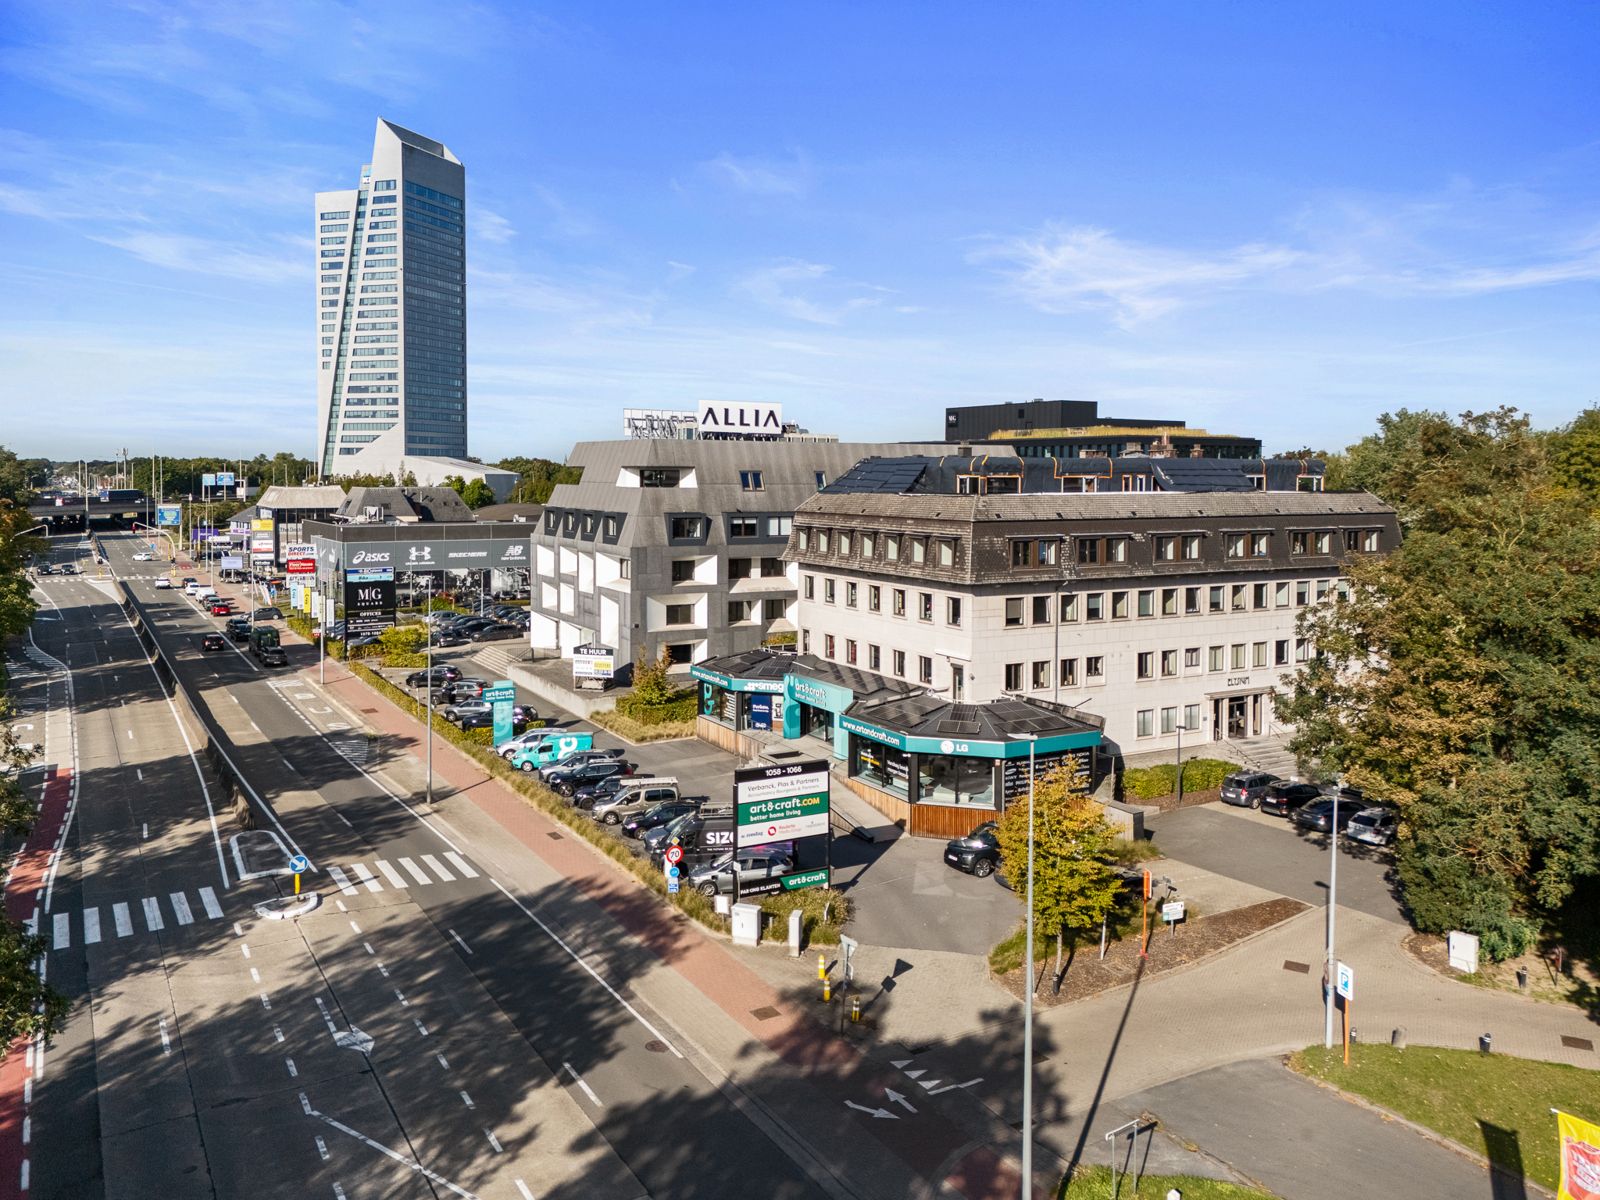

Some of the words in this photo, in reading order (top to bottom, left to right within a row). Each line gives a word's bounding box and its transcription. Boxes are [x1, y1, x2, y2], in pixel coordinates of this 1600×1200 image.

[702, 407, 780, 428] ALLIA
[364, 552, 391, 562] asics
[757, 682, 784, 692] smeg
[842, 720, 900, 746] www.artandcraft.com
[956, 743, 969, 753] LG
[765, 768, 782, 777] 1058
[786, 765, 803, 774] 1066
[785, 809, 802, 817] living
[670, 850, 680, 858] 70
